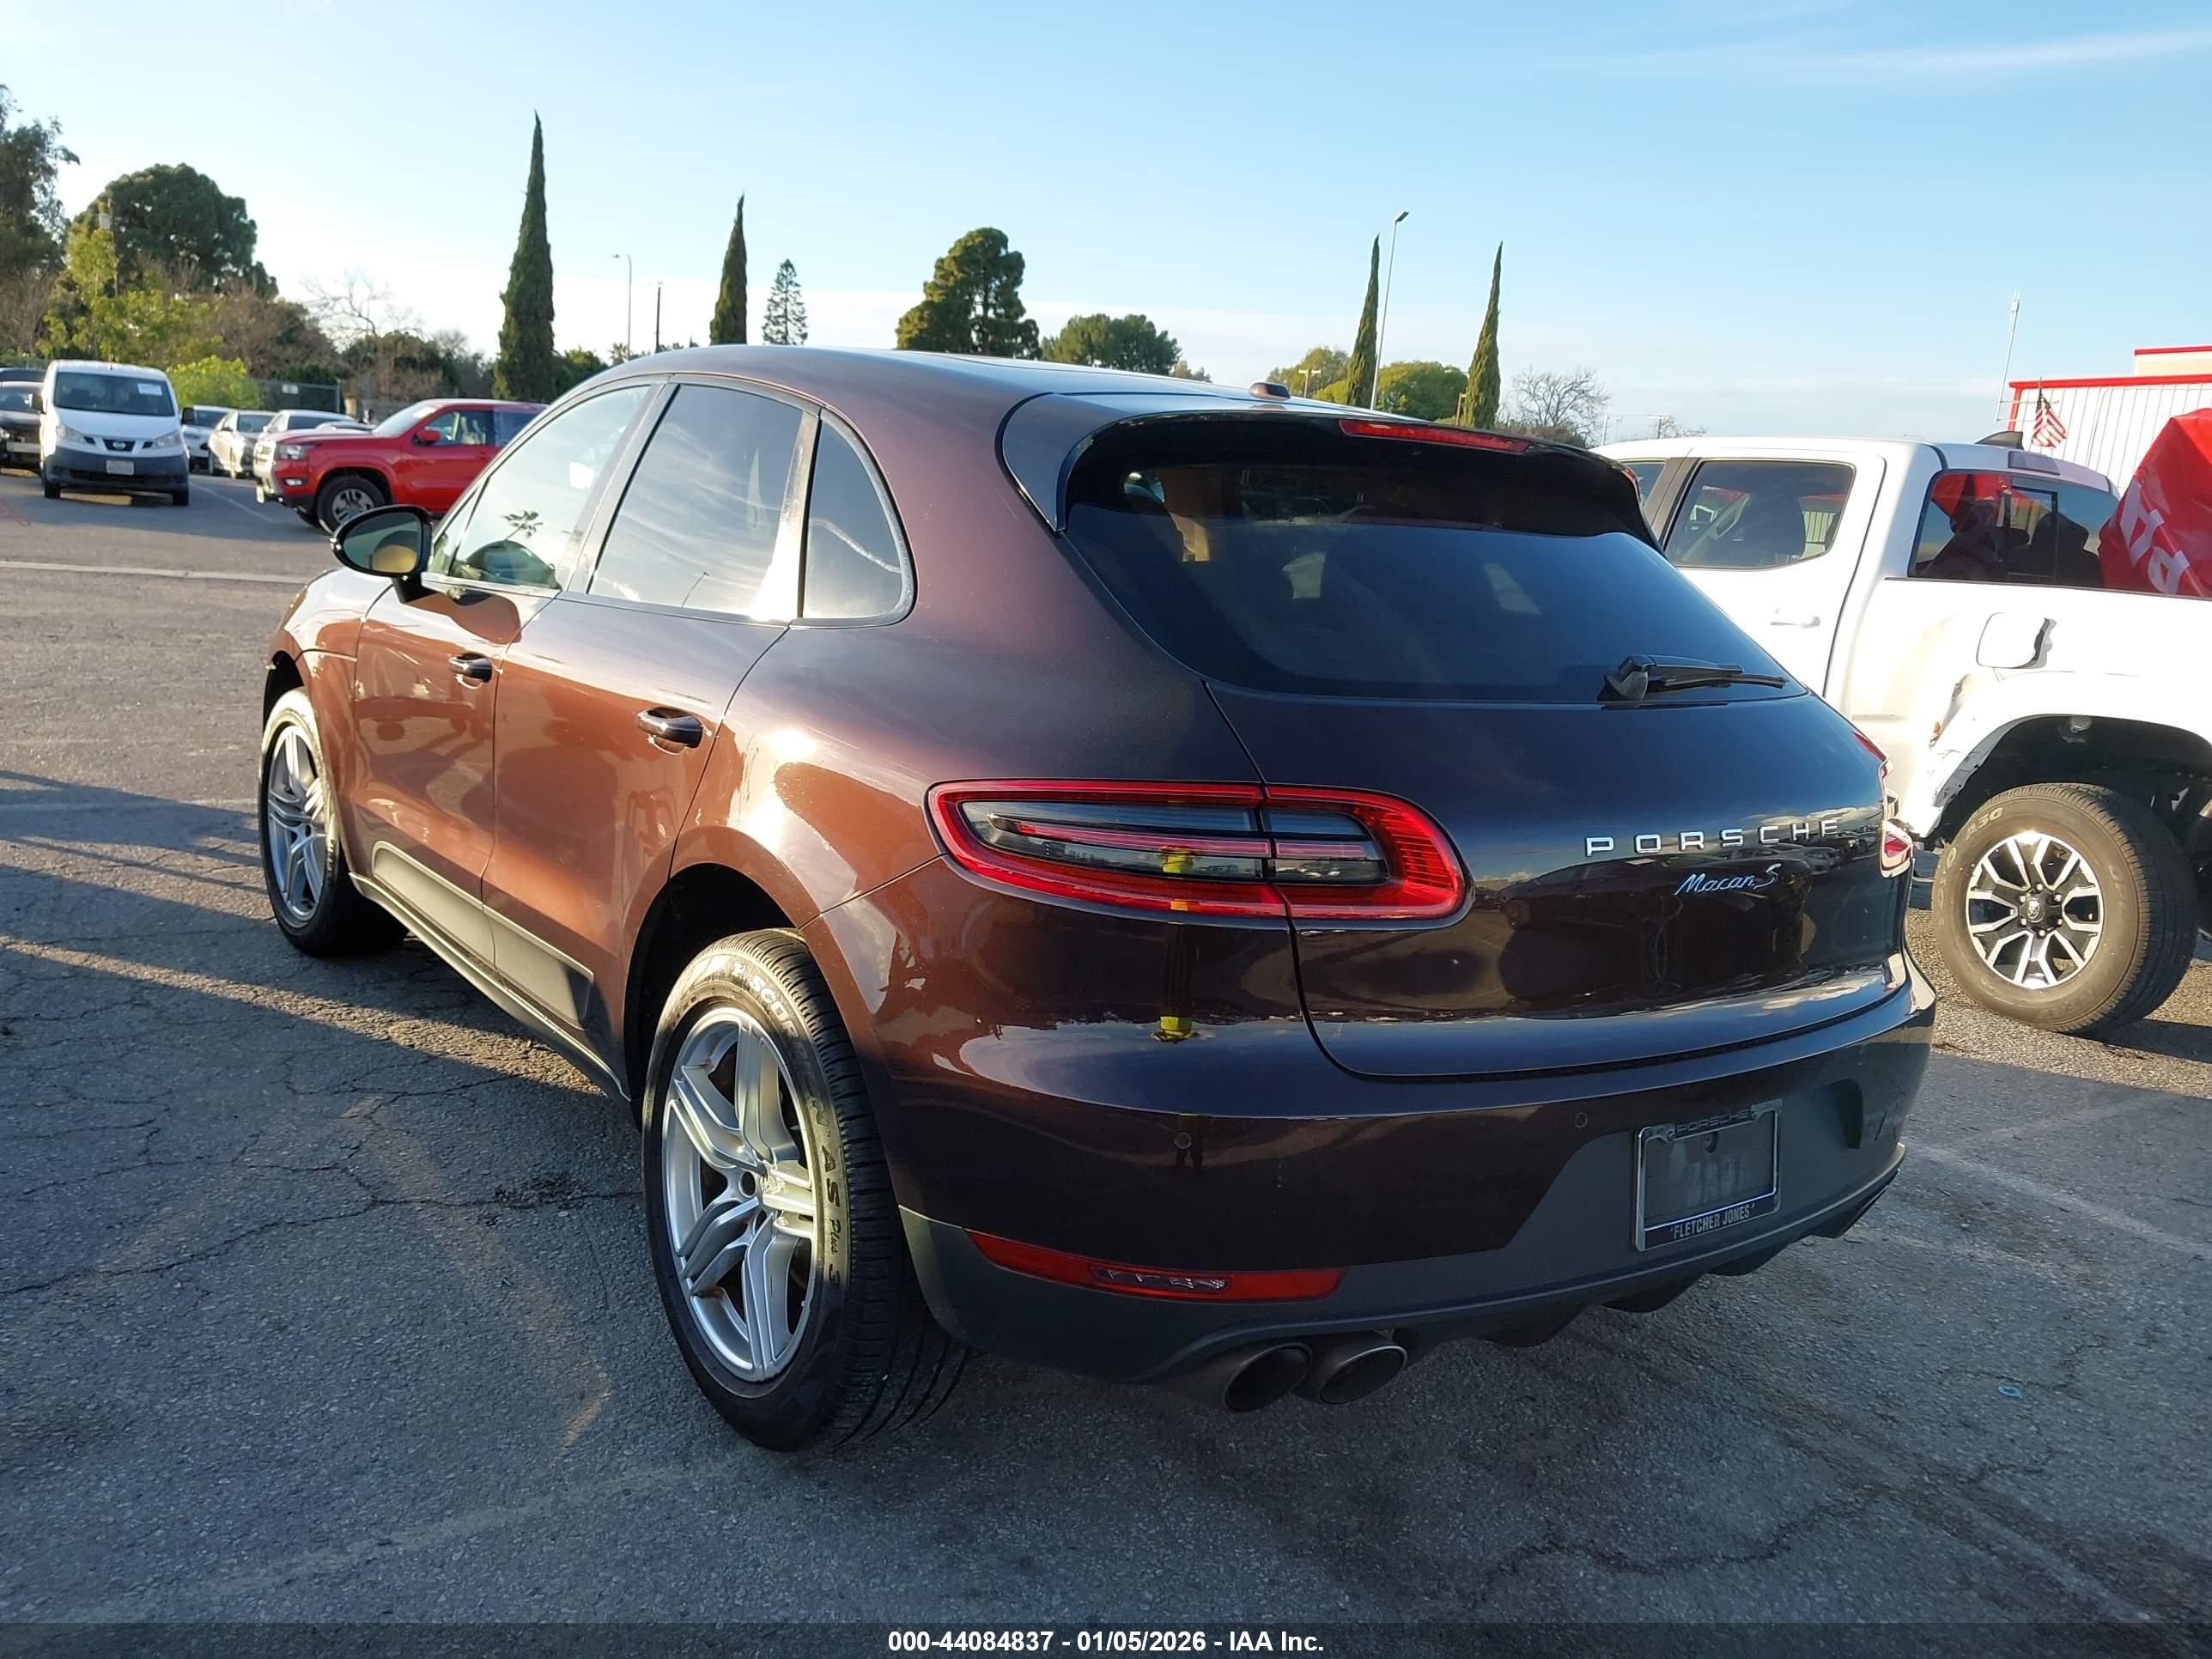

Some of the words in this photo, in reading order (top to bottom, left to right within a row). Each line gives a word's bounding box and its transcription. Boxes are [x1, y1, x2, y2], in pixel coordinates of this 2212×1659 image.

[1585, 817, 1841, 858] PORSCHE
[1965, 806, 2004, 842] A30
[1674, 872, 1756, 896] Macan
[1753, 862, 1783, 890] S
[829, 1217, 842, 1256] Plus
